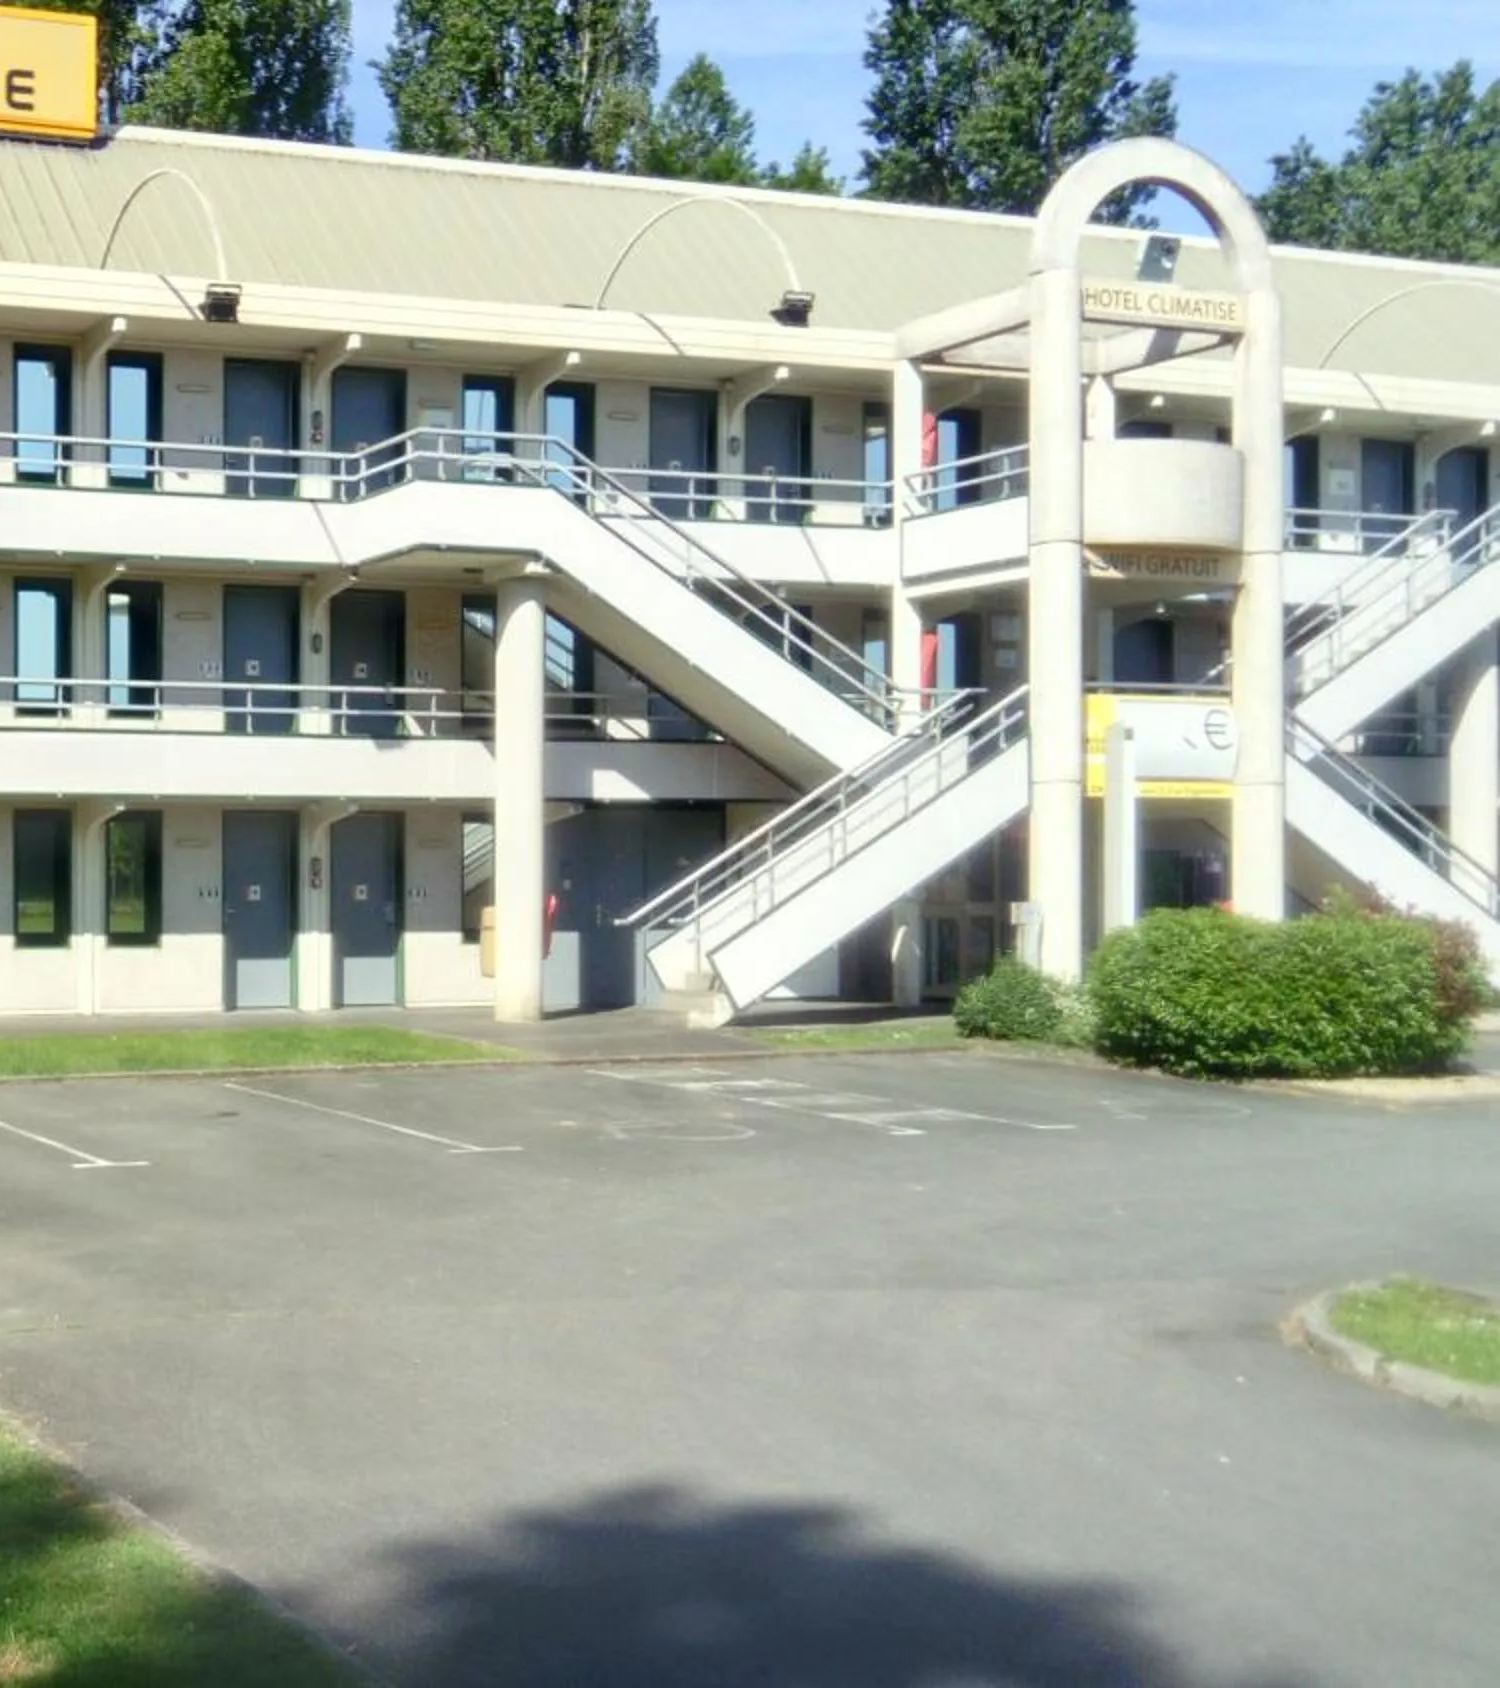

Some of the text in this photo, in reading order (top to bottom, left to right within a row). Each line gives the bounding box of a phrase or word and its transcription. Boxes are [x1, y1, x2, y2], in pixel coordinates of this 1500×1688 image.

[1085, 288, 1237, 321] HOTEL CLIMATISE
[1146, 554, 1220, 577] GRATUIT
